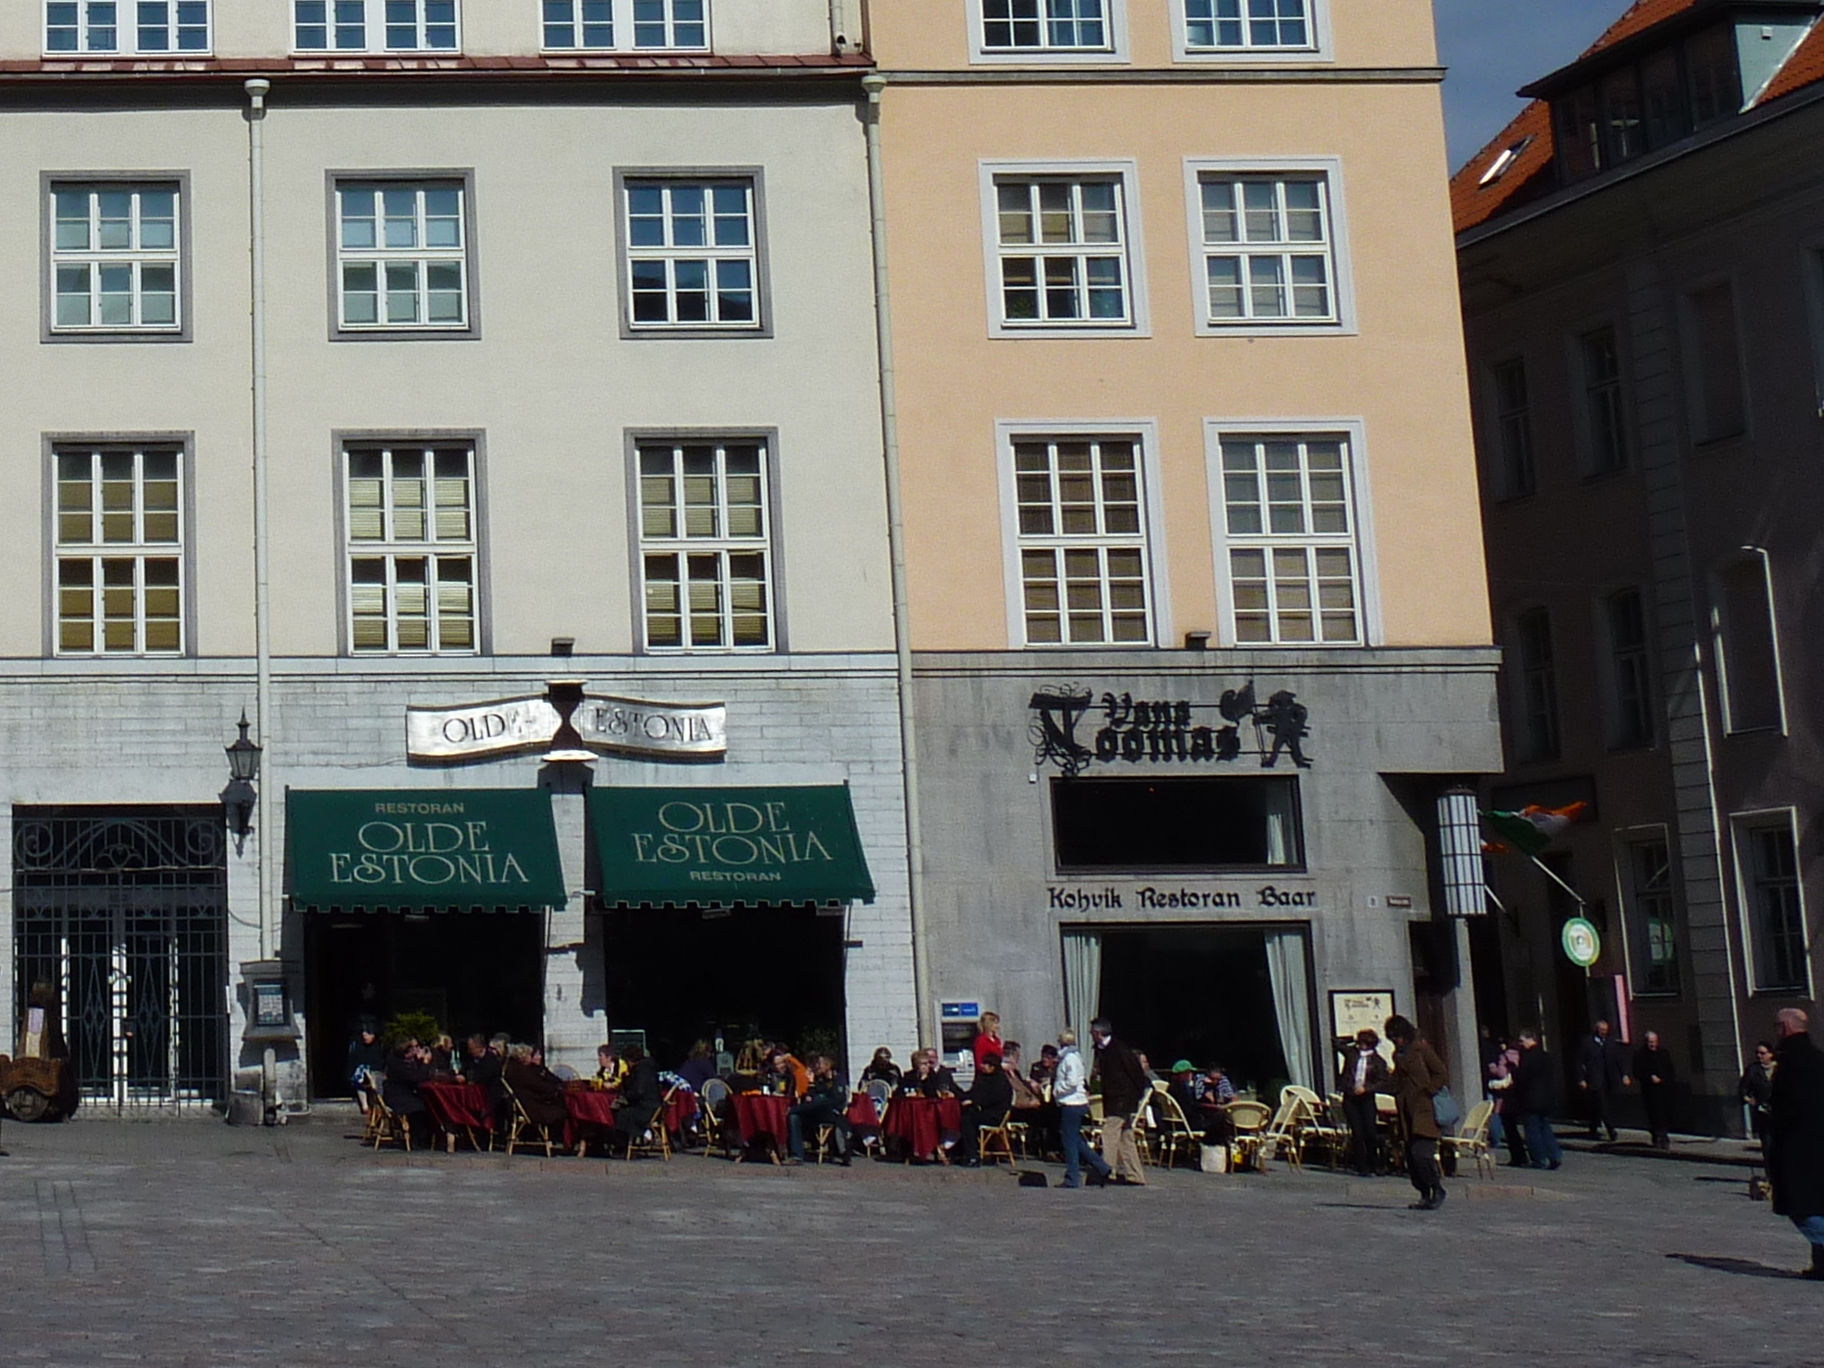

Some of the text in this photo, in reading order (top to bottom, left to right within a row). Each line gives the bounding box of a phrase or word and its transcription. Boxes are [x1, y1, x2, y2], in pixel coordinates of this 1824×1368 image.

[594, 707, 714, 742] ESTONIA
[375, 802, 465, 815] RESTORAN
[658, 801, 791, 833] OLDE
[358, 820, 490, 853] OLDE
[631, 830, 834, 865] ESTONIA
[328, 852, 530, 885] ESTONIA
[689, 870, 782, 882] RESTORAN
[1047, 885, 1316, 913] Kohvik Restoran Baar
